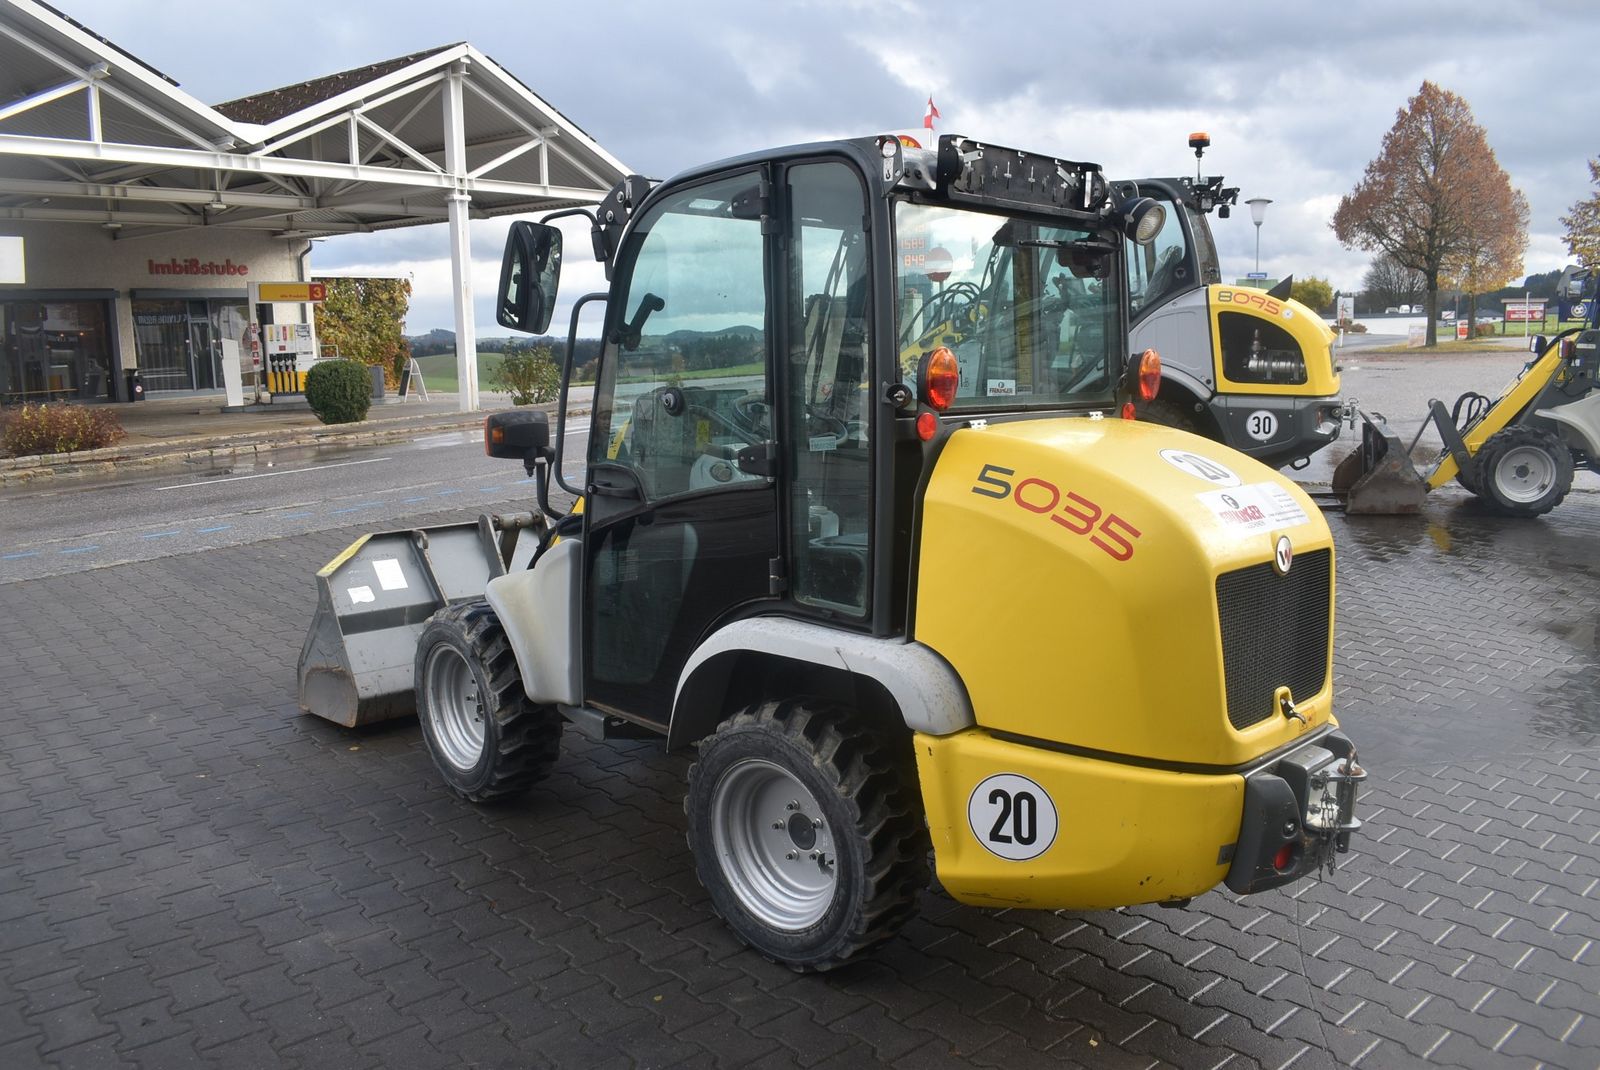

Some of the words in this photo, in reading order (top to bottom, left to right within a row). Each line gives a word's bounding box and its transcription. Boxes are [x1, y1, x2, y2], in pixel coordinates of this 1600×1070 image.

[148, 258, 248, 276] Imbißstube
[312, 286, 322, 298] 3
[1218, 290, 1280, 316] 8095
[1252, 416, 1272, 434] 30
[971, 463, 1142, 562] 5035
[988, 788, 1037, 846] 20
